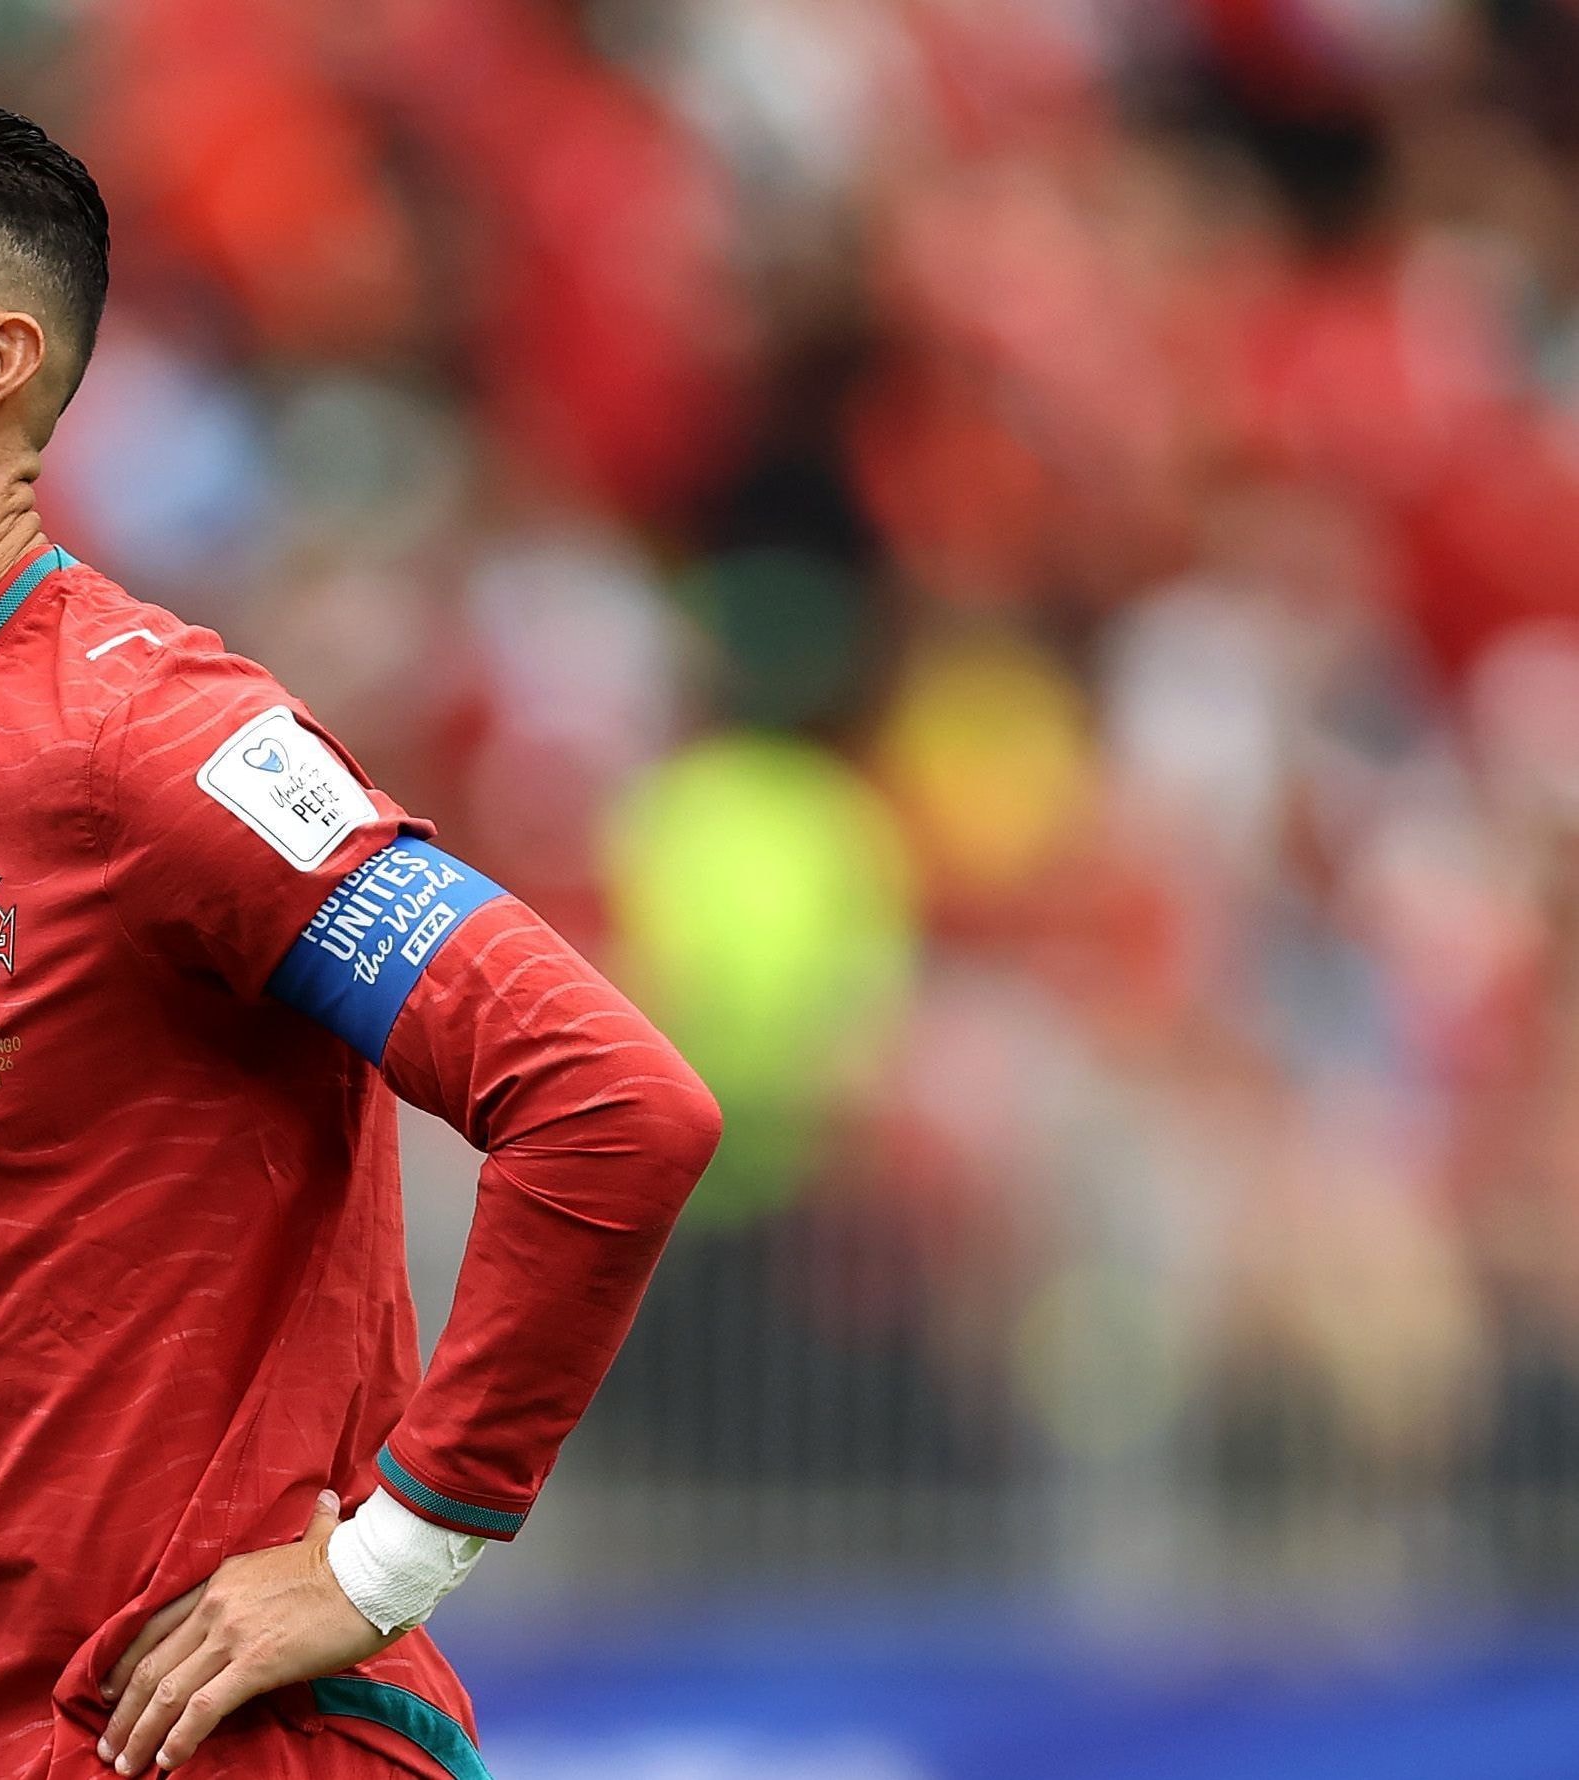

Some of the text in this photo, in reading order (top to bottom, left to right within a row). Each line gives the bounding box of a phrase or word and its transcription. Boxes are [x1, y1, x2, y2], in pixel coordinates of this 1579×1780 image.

[321, 808, 343, 827] FI
[320, 850, 429, 961] UNITES
[353, 863, 466, 985] the World
[406, 909, 451, 959] FIFA
